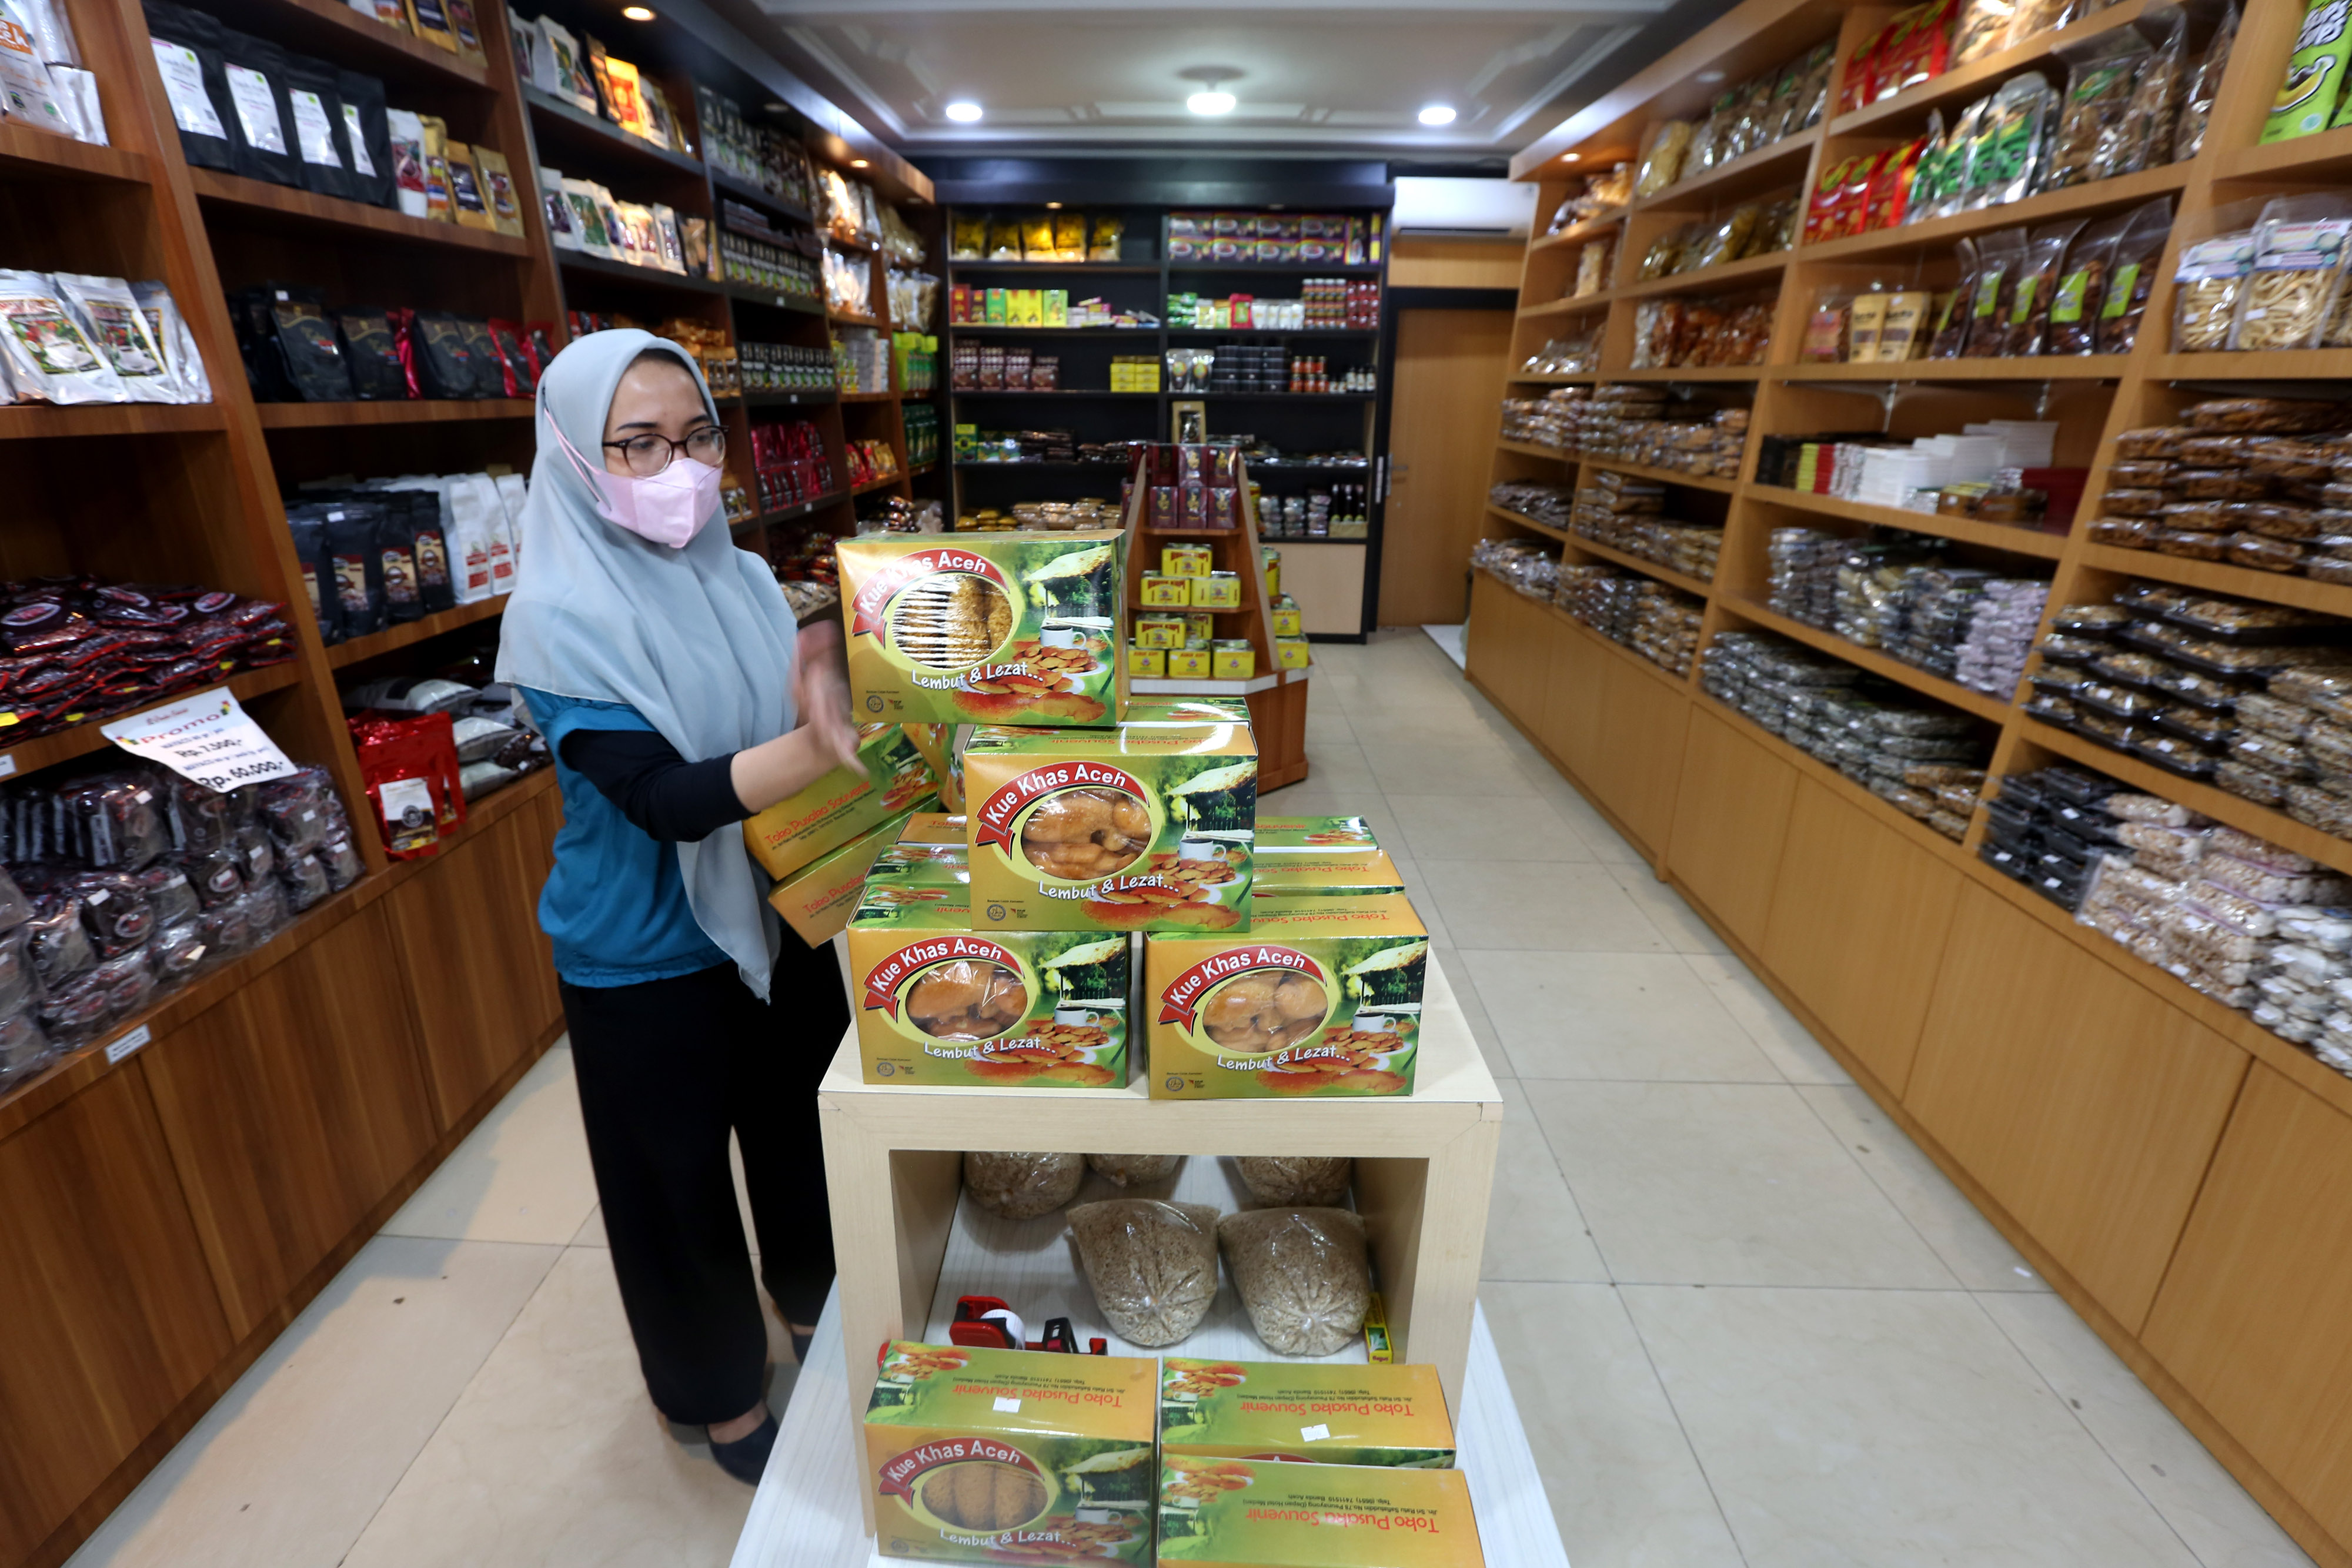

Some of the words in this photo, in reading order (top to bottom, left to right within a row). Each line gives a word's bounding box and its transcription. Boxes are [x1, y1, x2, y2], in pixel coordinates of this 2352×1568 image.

[859, 585, 887, 614] Kue
[885, 557, 934, 587] Khas
[937, 550, 987, 574] Aceh
[911, 669, 965, 691] Lembut
[970, 667, 981, 683] &
[986, 662, 1044, 682] Lezat...
[141, 714, 219, 743] promo
[198, 775, 230, 790] Rp.
[986, 794, 1017, 825] Kue
[1015, 767, 1069, 796] Khas
[1074, 764, 1127, 788] Aceh
[764, 826, 791, 845] Toko
[790, 805, 830, 831] Pusaka
[827, 780, 871, 809] Souvenir
[1038, 880, 1095, 901] Lembut
[1101, 878, 1114, 895] &
[1118, 873, 1180, 893] Lezat...
[803, 895, 829, 914] Toko
[872, 964, 901, 992] Kue
[900, 940, 948, 967] Khas
[953, 938, 1003, 960] Aceh
[1170, 976, 1202, 1005] Kue
[1201, 950, 1251, 977] Khas
[1256, 948, 1306, 969] Aceh
[924, 1041, 977, 1059] Lembut
[983, 1041, 995, 1053] &
[1000, 1036, 1057, 1054] Lezat...
[1217, 1054, 1272, 1071] Lembut
[1277, 1052, 1290, 1065] &
[1294, 1044, 1351, 1062] Lezat...
[951, 1385, 1017, 1400] Souvenir
[1023, 1389, 1079, 1403] Pusaka
[1085, 1393, 1122, 1407] Toko
[1240, 1402, 1306, 1415] Souvenir
[1311, 1403, 1369, 1416] Pusaka
[1374, 1404, 1414, 1416] Toko
[887, 1459, 916, 1482] Kue
[916, 1442, 964, 1466] Khas
[970, 1440, 1021, 1464] Aceh
[1246, 1508, 1319, 1526] Souvenir
[1324, 1512, 1389, 1530] Pusaka
[1395, 1516, 1439, 1533] Toko
[940, 1528, 995, 1547] Lembut
[1000, 1530, 1014, 1544] &
[1018, 1530, 1077, 1549] Lezat...
